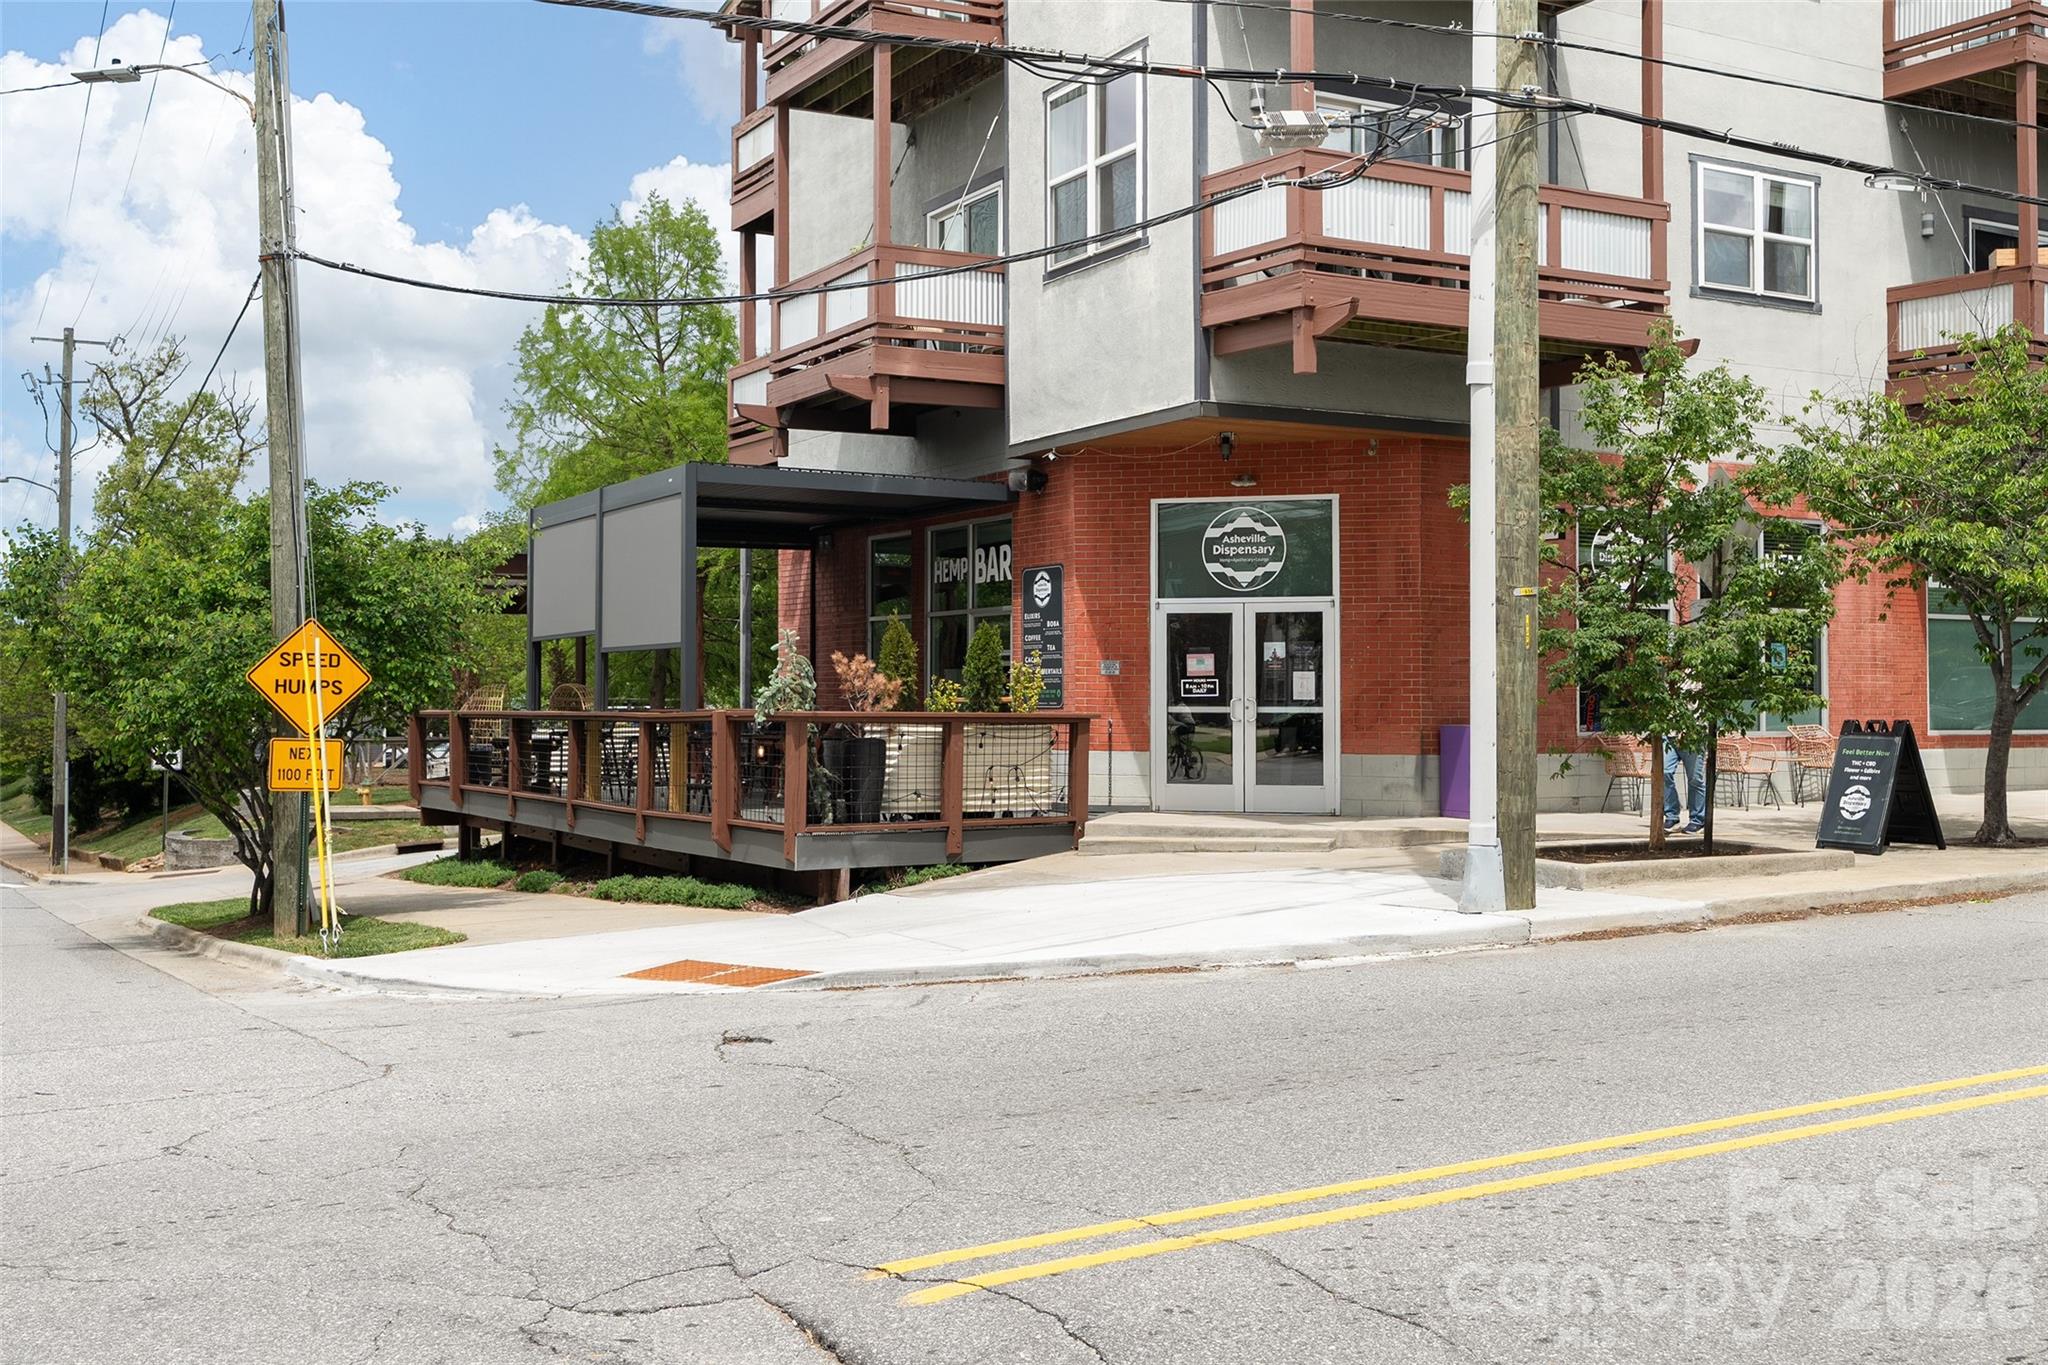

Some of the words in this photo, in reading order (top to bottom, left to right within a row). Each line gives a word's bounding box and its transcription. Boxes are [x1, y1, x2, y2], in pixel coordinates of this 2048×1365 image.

[1222, 533, 1267, 544] Asheville
[1212, 544, 1276, 557] Dispensary
[934, 557, 968, 584] HEMP
[975, 544, 1013, 584] BAR
[1046, 620, 1060, 628] BOBA
[1024, 634, 1041, 642] COFFEE
[280, 652, 341, 667] SPEED
[275, 679, 343, 695] HUMPS
[277, 768, 301, 781] 1100
